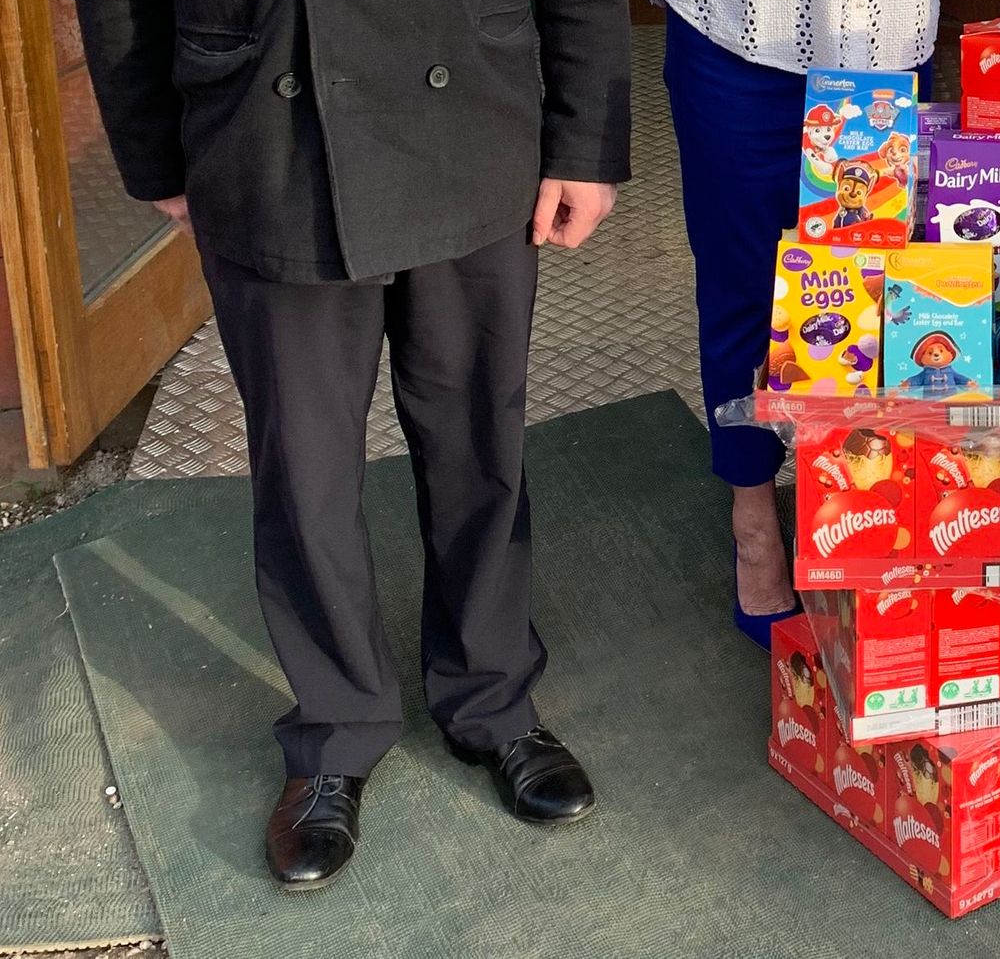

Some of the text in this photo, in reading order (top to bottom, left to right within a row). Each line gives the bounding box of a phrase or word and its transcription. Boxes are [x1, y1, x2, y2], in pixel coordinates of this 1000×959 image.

[944, 157, 978, 171] Cadbury
[935, 170, 978, 190] Dairy
[784, 253, 811, 266] Cadbury
[801, 267, 849, 290] Mini
[800, 288, 855, 309] eggs
[812, 455, 849, 491] Maltesers
[930, 452, 967, 488] Maltesers
[812, 508, 897, 558] Maltesers
[880, 565, 915, 585] Maltesers
[777, 717, 817, 747] Maltesers
[833, 763, 875, 796] Maltesers
[893, 752, 913, 795] Maltesers
[968, 756, 998, 787] Maltesers
[893, 814, 940, 849] Maltesers
